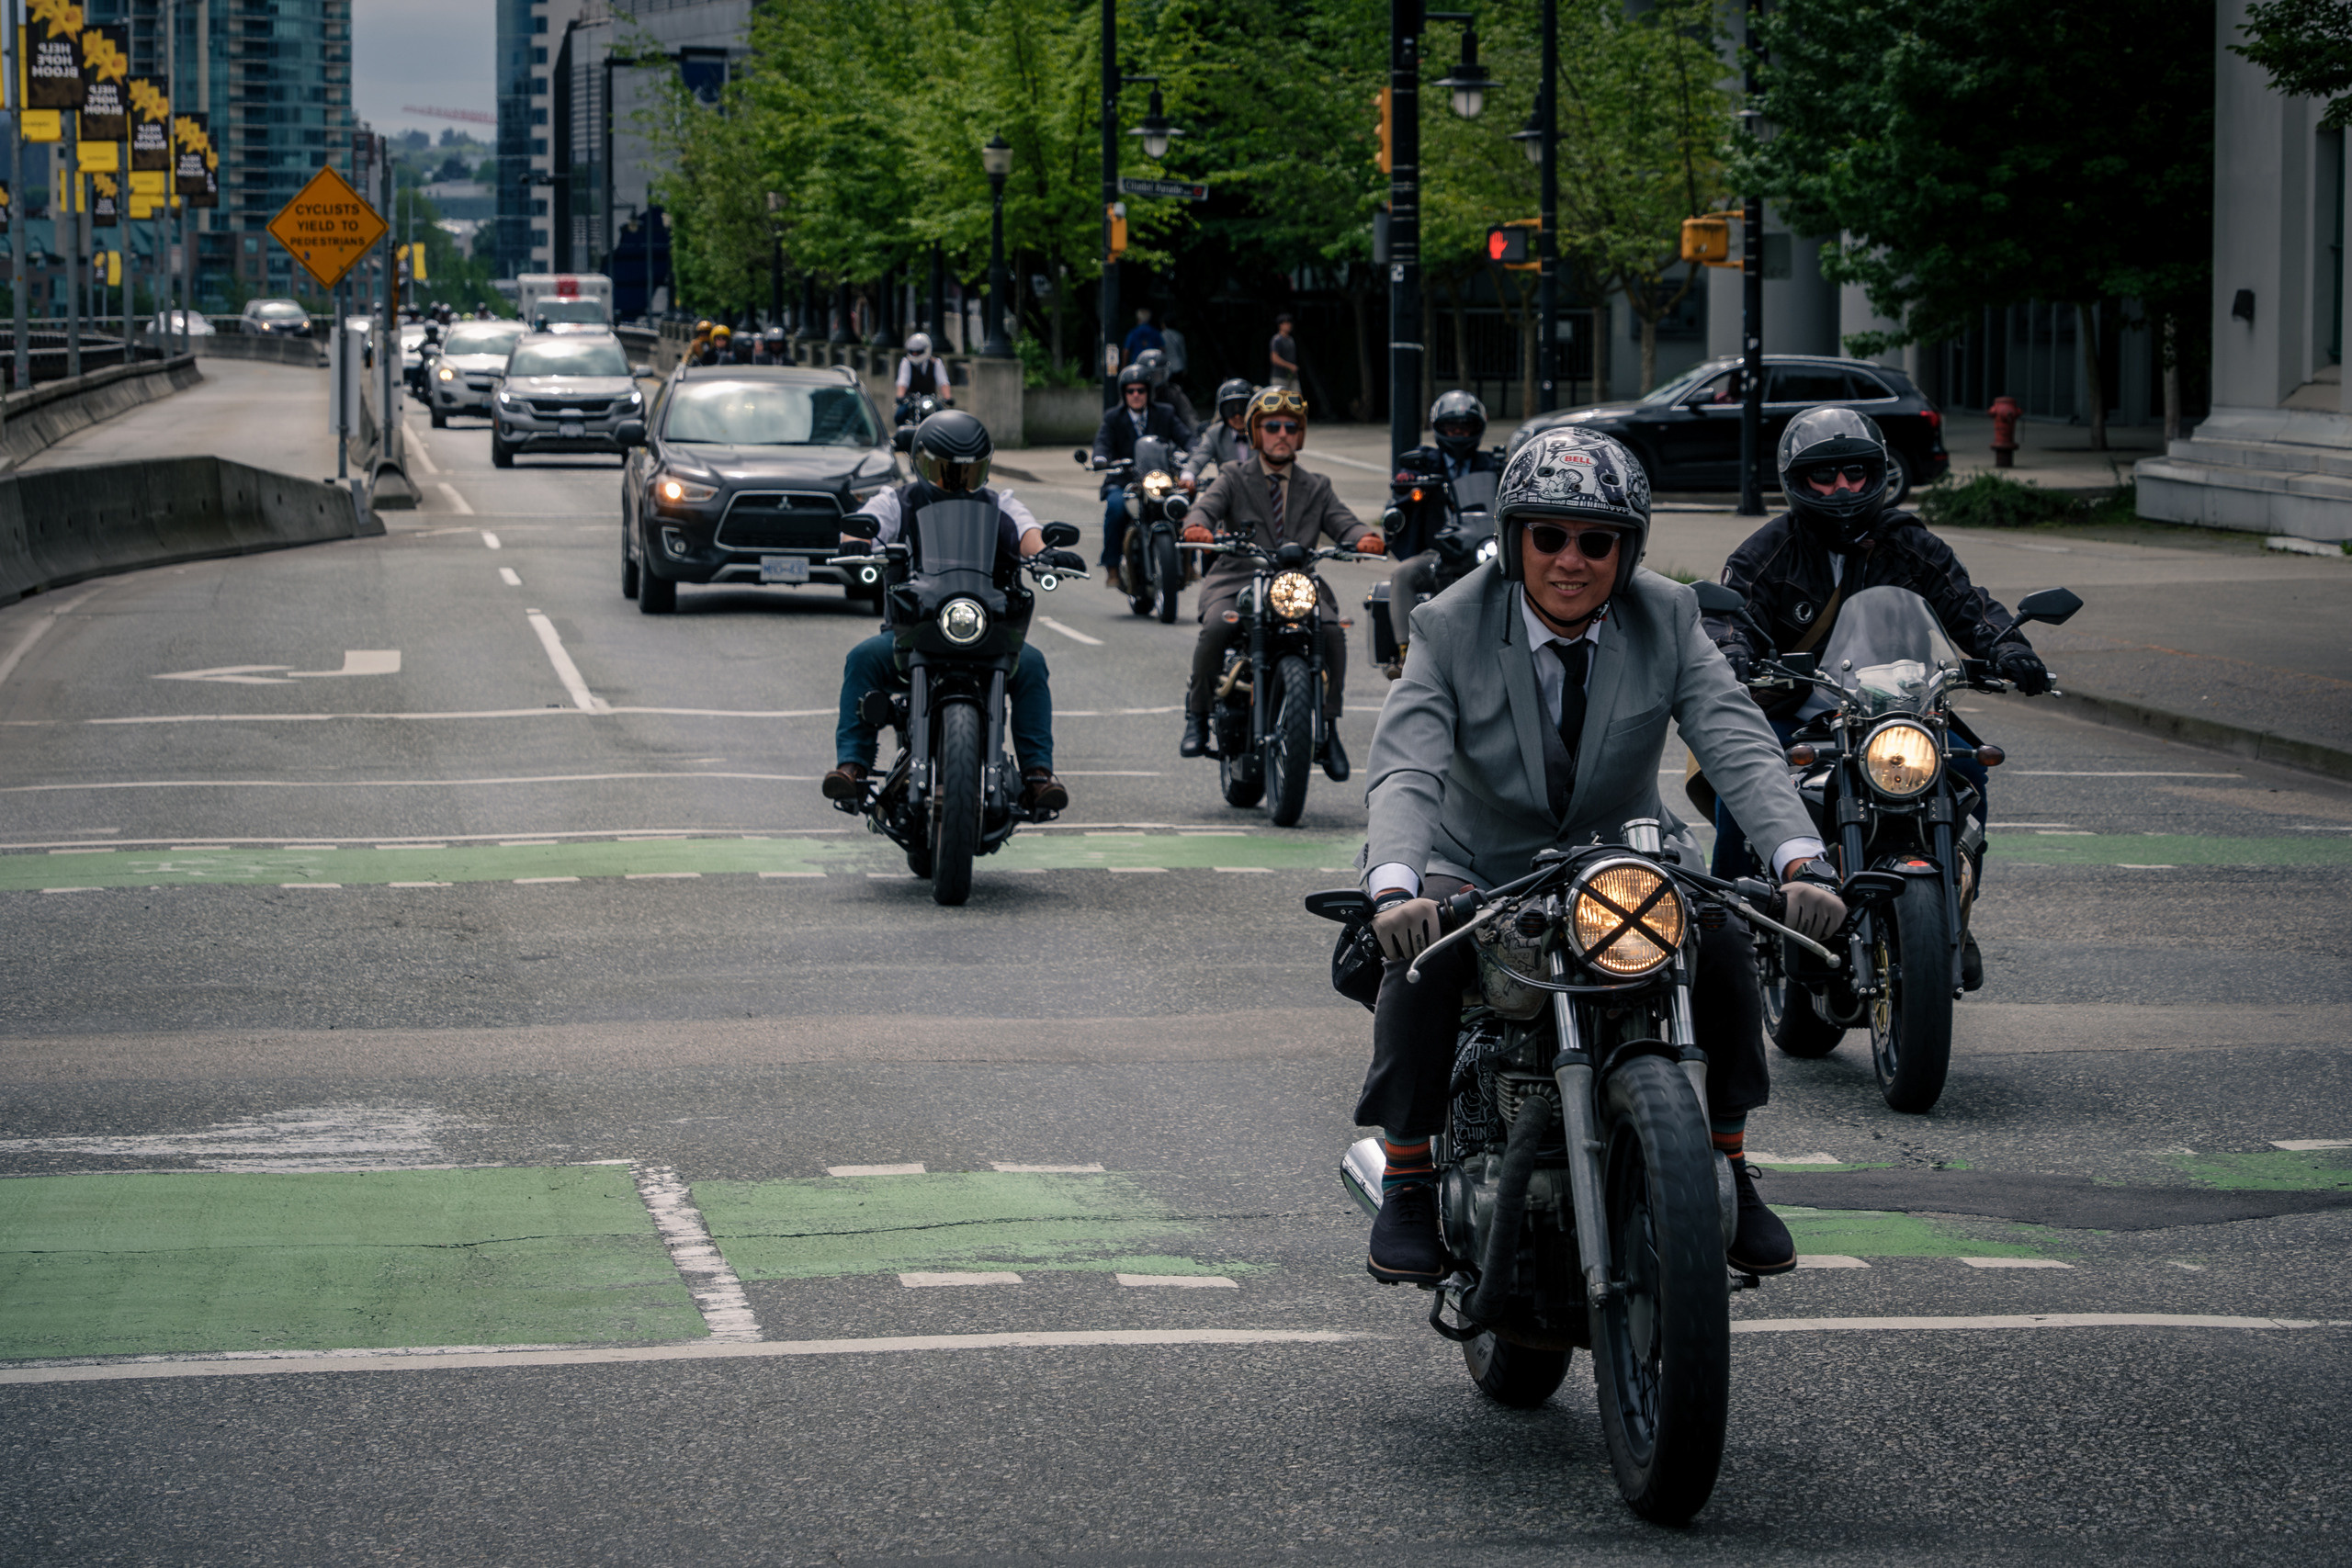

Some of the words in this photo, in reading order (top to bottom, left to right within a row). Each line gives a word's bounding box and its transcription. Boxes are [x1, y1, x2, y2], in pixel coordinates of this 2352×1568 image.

[295, 204, 360, 216] CYCLISTS
[297, 220, 335, 231] YIELD
[342, 220, 358, 231] TO
[289, 237, 366, 246] PEDESTRIANS
[1565, 456, 1592, 464] BELL
